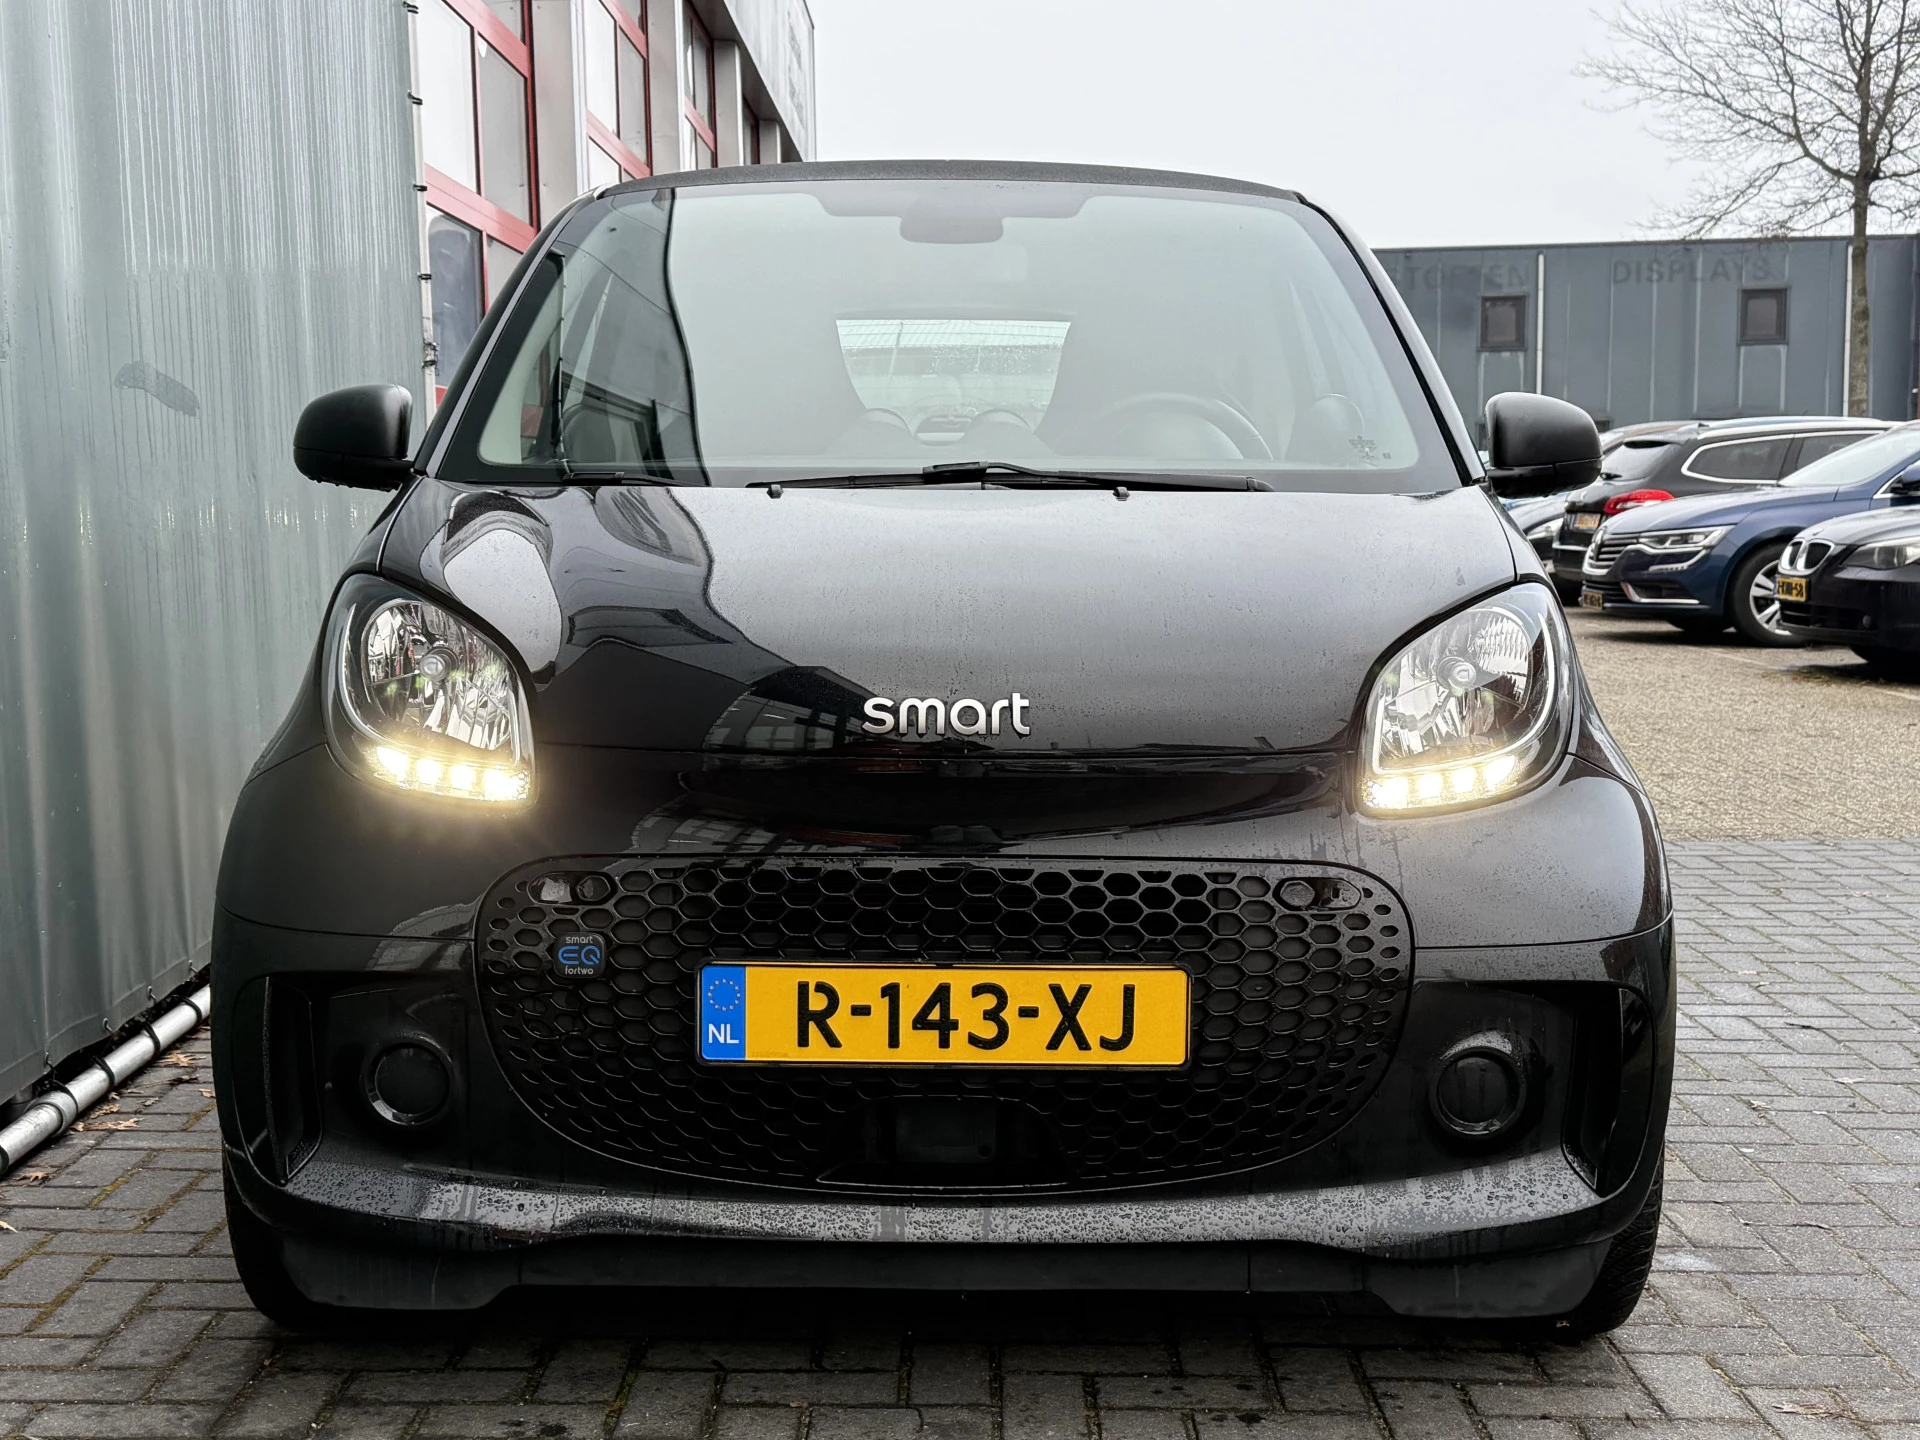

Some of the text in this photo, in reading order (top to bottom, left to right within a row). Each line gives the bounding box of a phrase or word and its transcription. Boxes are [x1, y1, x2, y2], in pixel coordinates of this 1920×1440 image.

[1613, 255, 1770, 285] DISPLAYS
[861, 692, 1031, 736] smart
[565, 935, 594, 944] smart
[558, 945, 601, 965] EQ
[564, 965, 594, 975] fortwo
[797, 980, 1136, 1052] R-143-XJ
[707, 1023, 740, 1045] NL
